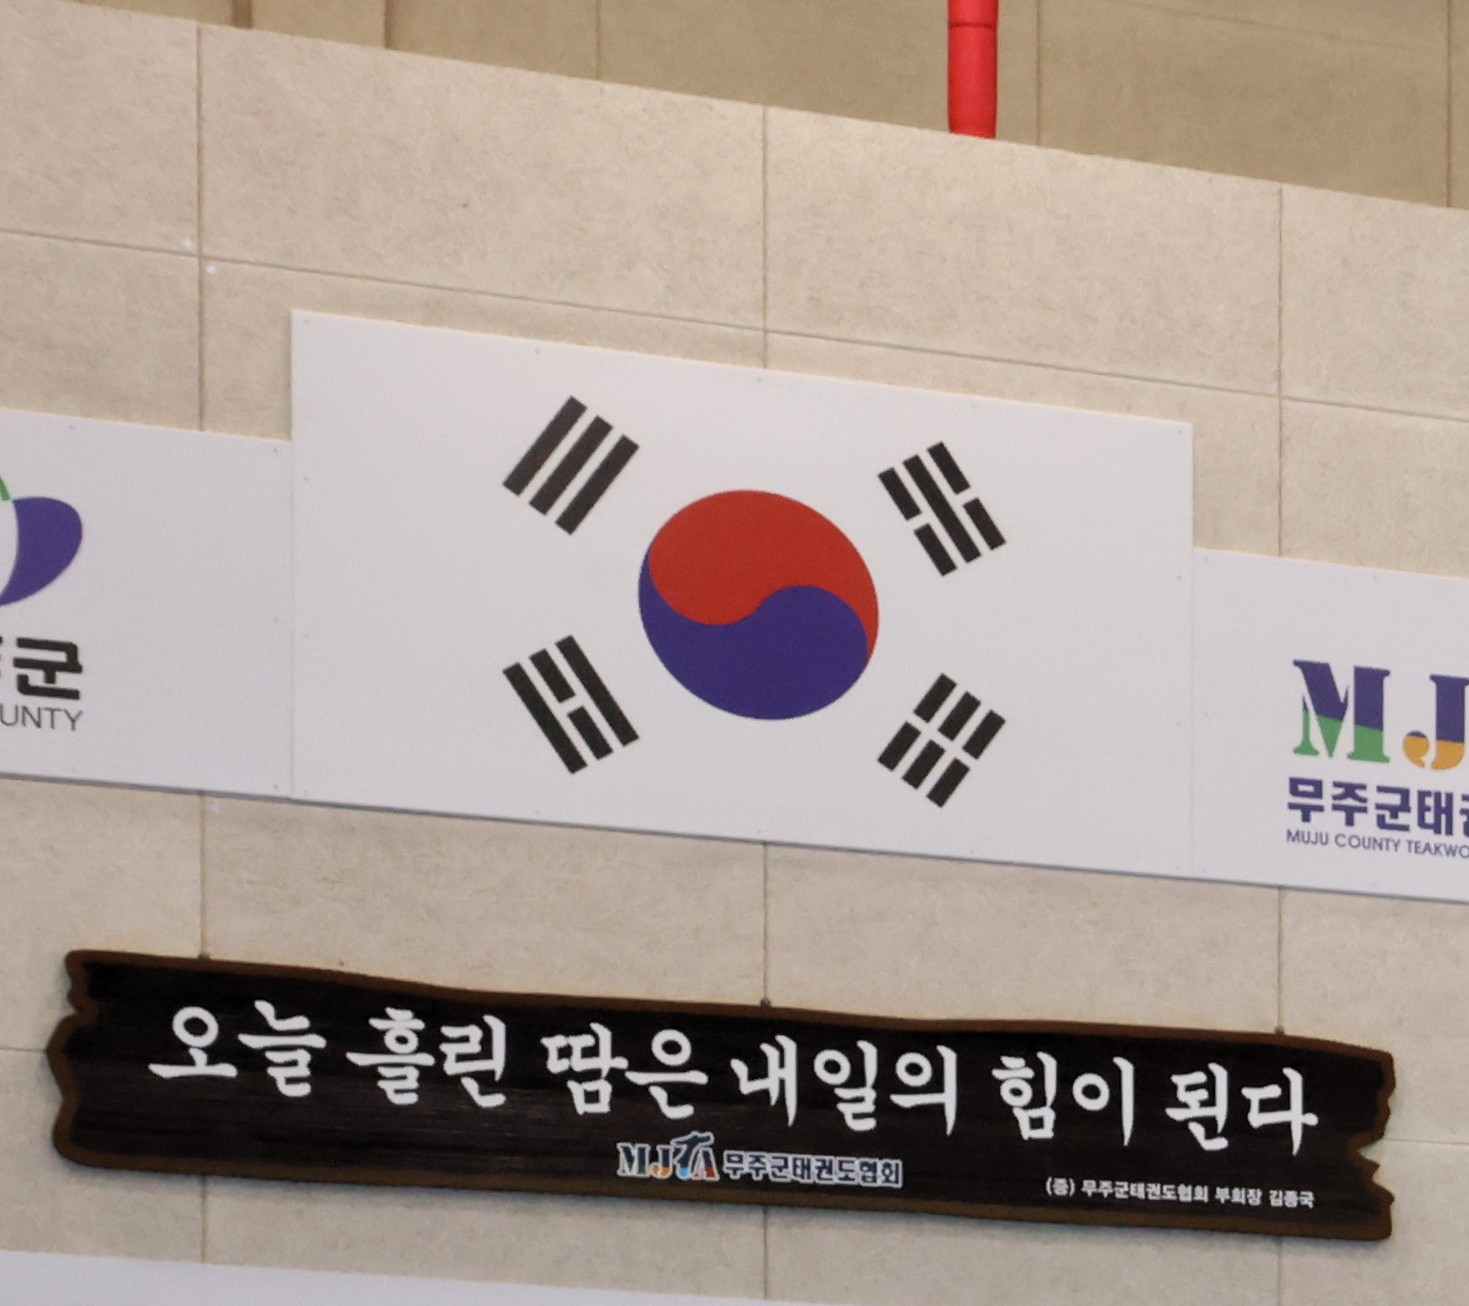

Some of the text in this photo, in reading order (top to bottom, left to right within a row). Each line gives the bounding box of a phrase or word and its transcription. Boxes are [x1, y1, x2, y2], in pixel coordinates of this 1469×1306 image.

[0, 635, 83, 700] 군
[1286, 828, 1330, 847] MUJU
[1334, 833, 1400, 854] COUNTY
[149, 1000, 1319, 1156] 오늘 흘린 땀은 내일의 힘이 된다
[722, 1150, 903, 1188] 무주군태권도협회
